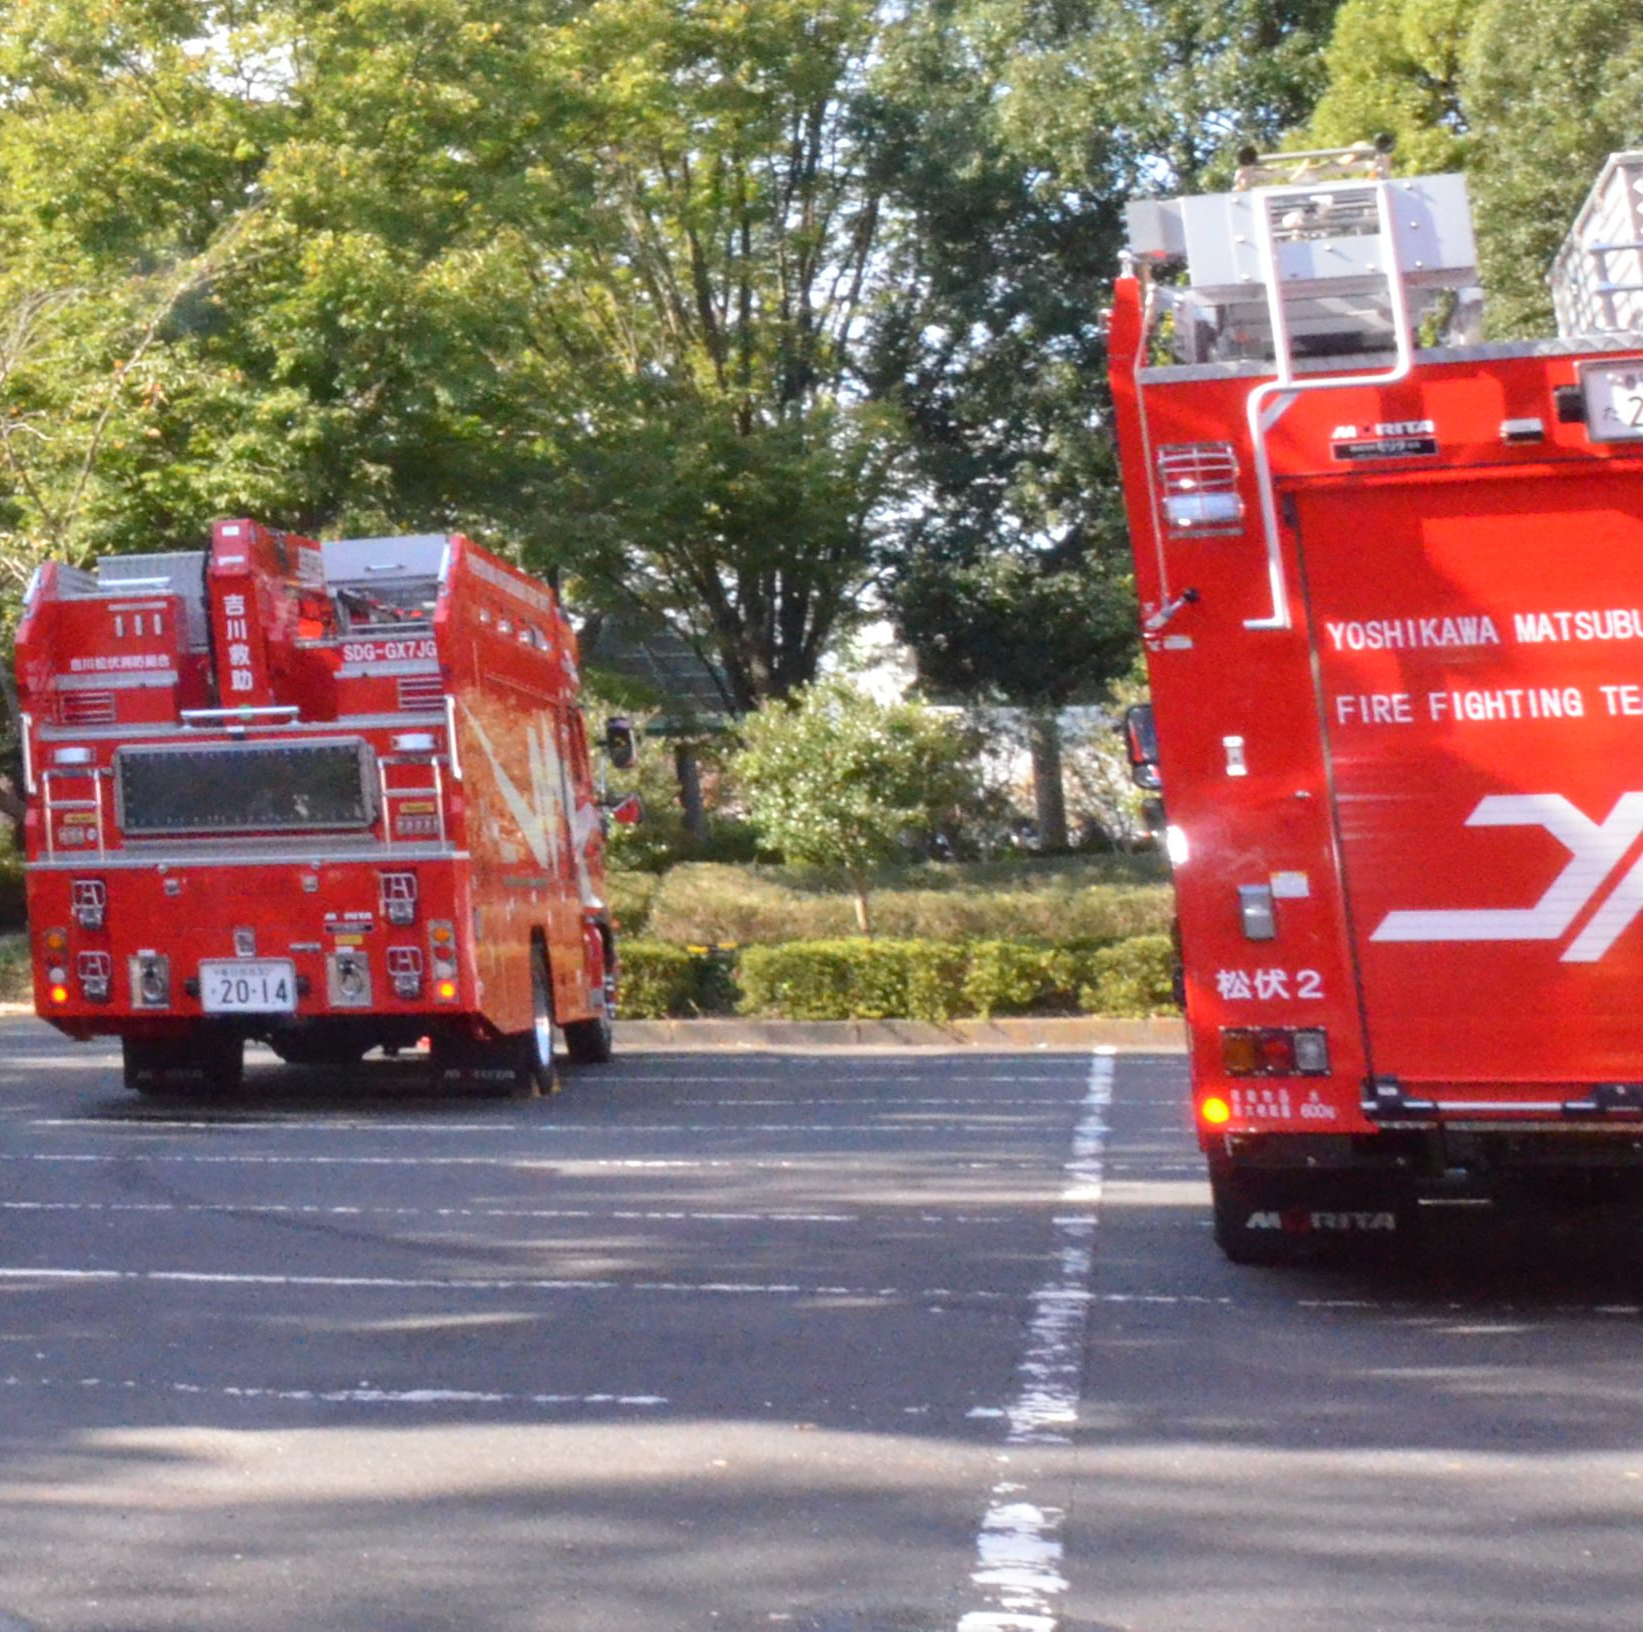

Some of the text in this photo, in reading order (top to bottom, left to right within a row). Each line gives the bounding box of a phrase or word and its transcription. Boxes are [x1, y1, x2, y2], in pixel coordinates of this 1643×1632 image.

[1327, 616, 1500, 651] YOSHIKAWA
[1335, 693, 1414, 725] FIRE
[1429, 687, 1584, 721] FIGHTING
